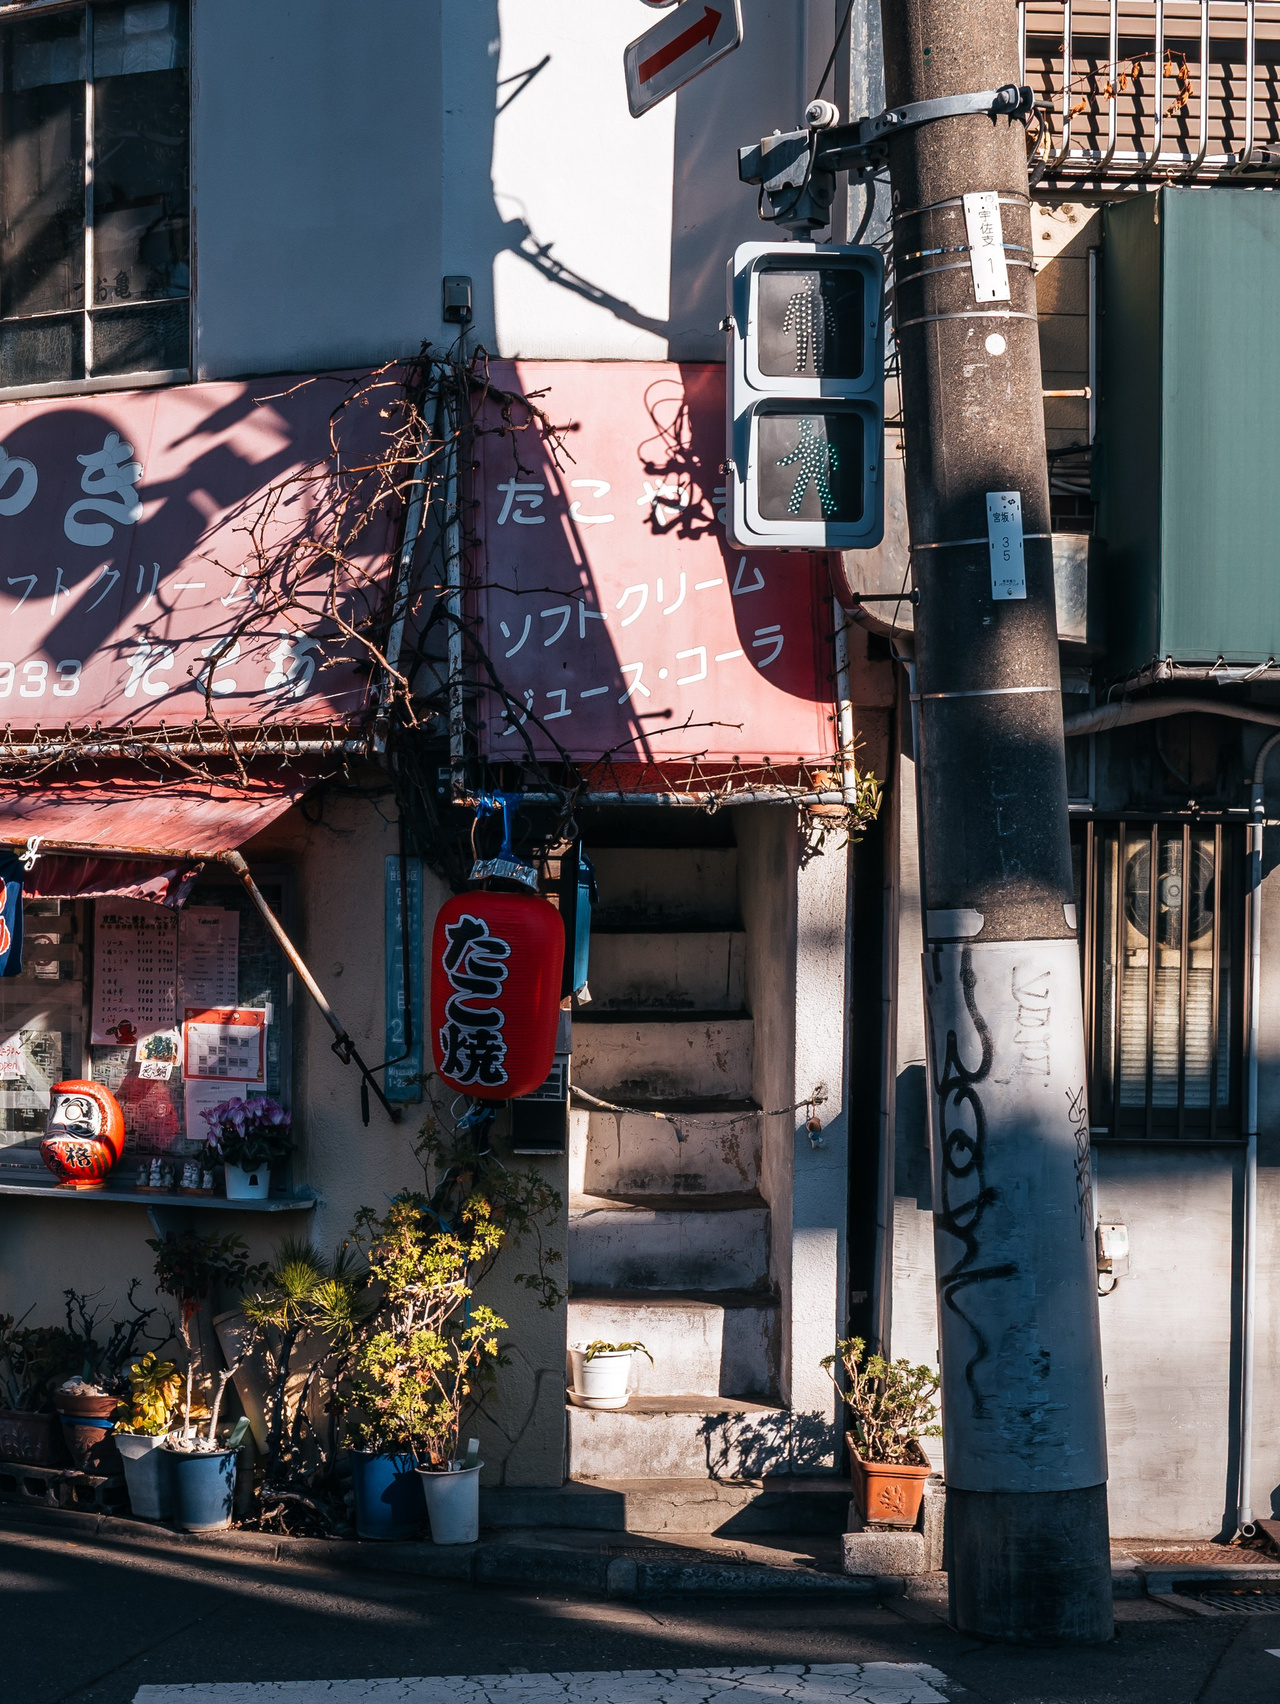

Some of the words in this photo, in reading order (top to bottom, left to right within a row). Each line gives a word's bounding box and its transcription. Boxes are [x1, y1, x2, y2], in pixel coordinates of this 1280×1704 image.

[497, 476, 726, 527] たこや
[500, 556, 765, 658] ソフトクリーム
[500, 624, 784, 736] ジュース・コーラ
[440, 913, 512, 1087] たこ焼
